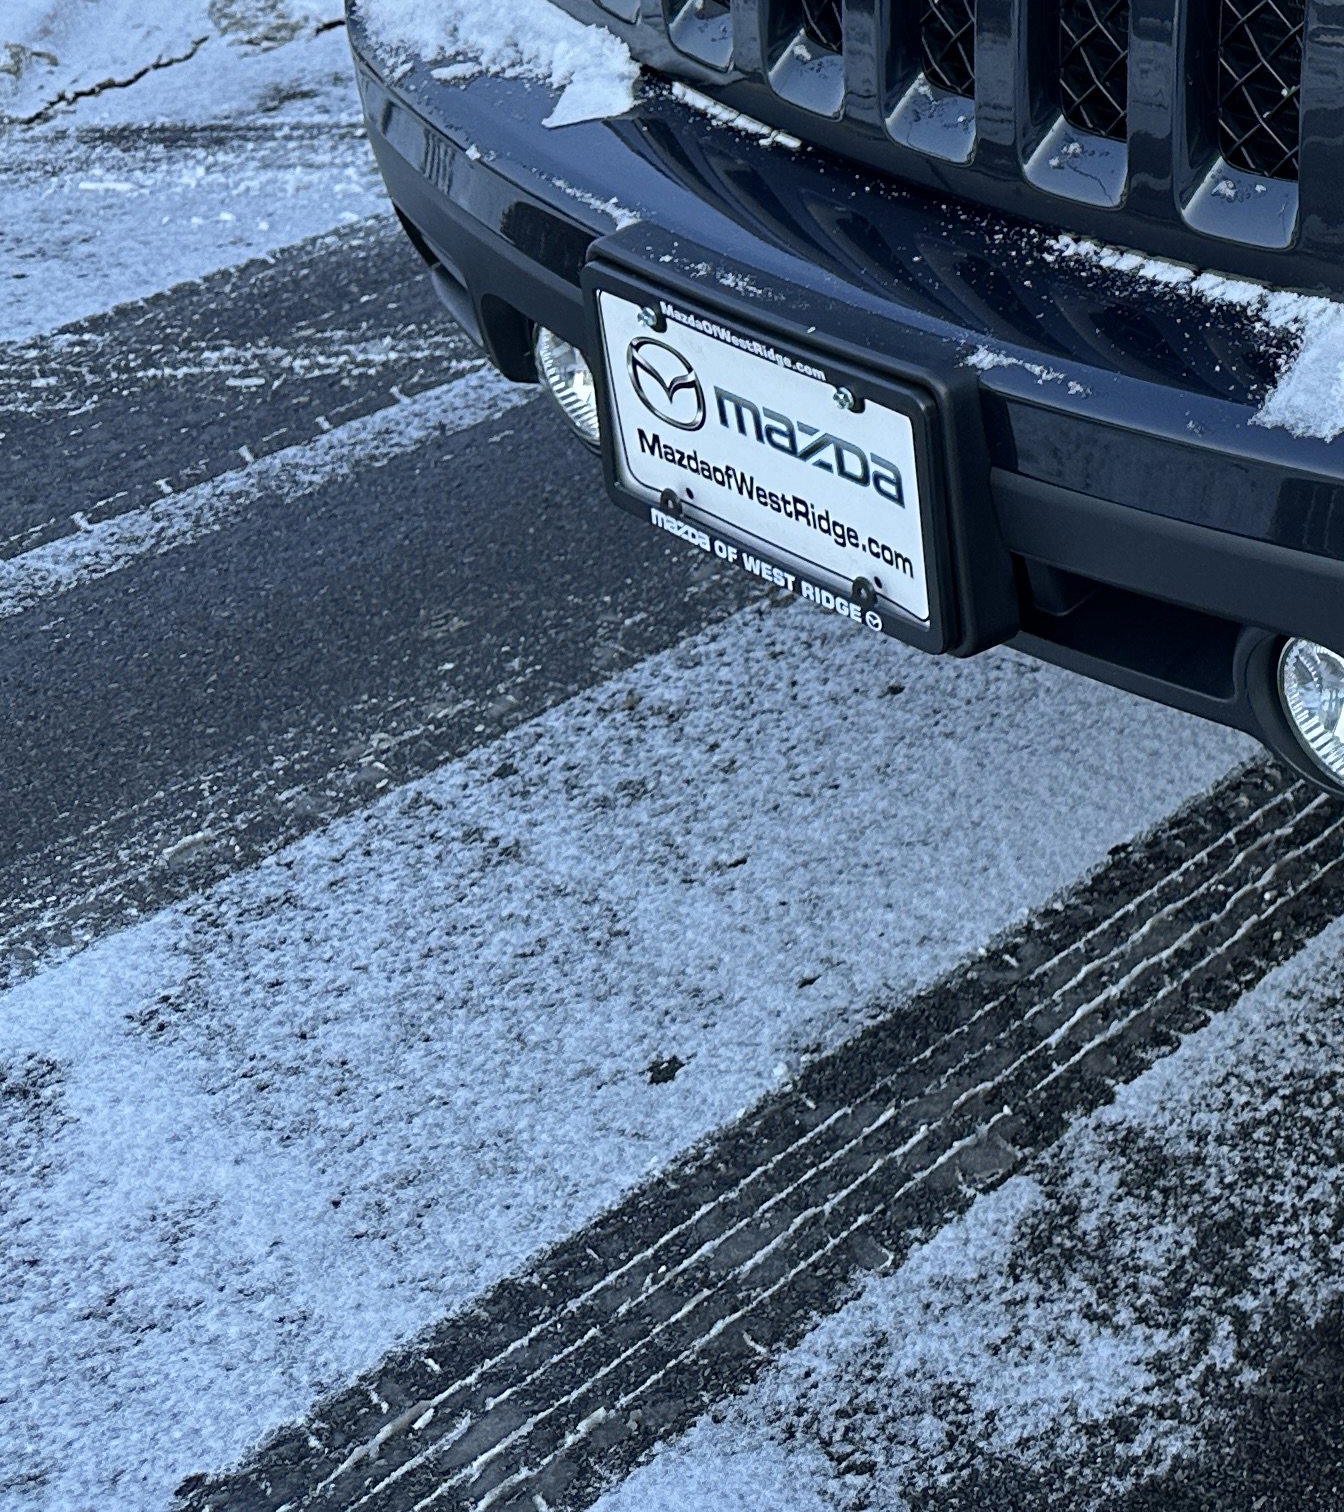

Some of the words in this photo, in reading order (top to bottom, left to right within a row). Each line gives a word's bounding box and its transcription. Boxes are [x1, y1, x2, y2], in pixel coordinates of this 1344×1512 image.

[659, 300, 827, 382] MazdaOfWestRidge.com
[636, 427, 915, 579] MazdaofWestRidge.com
[713, 539, 738, 564] OF
[741, 551, 796, 593] WEST
[800, 579, 864, 624] RIDGE
